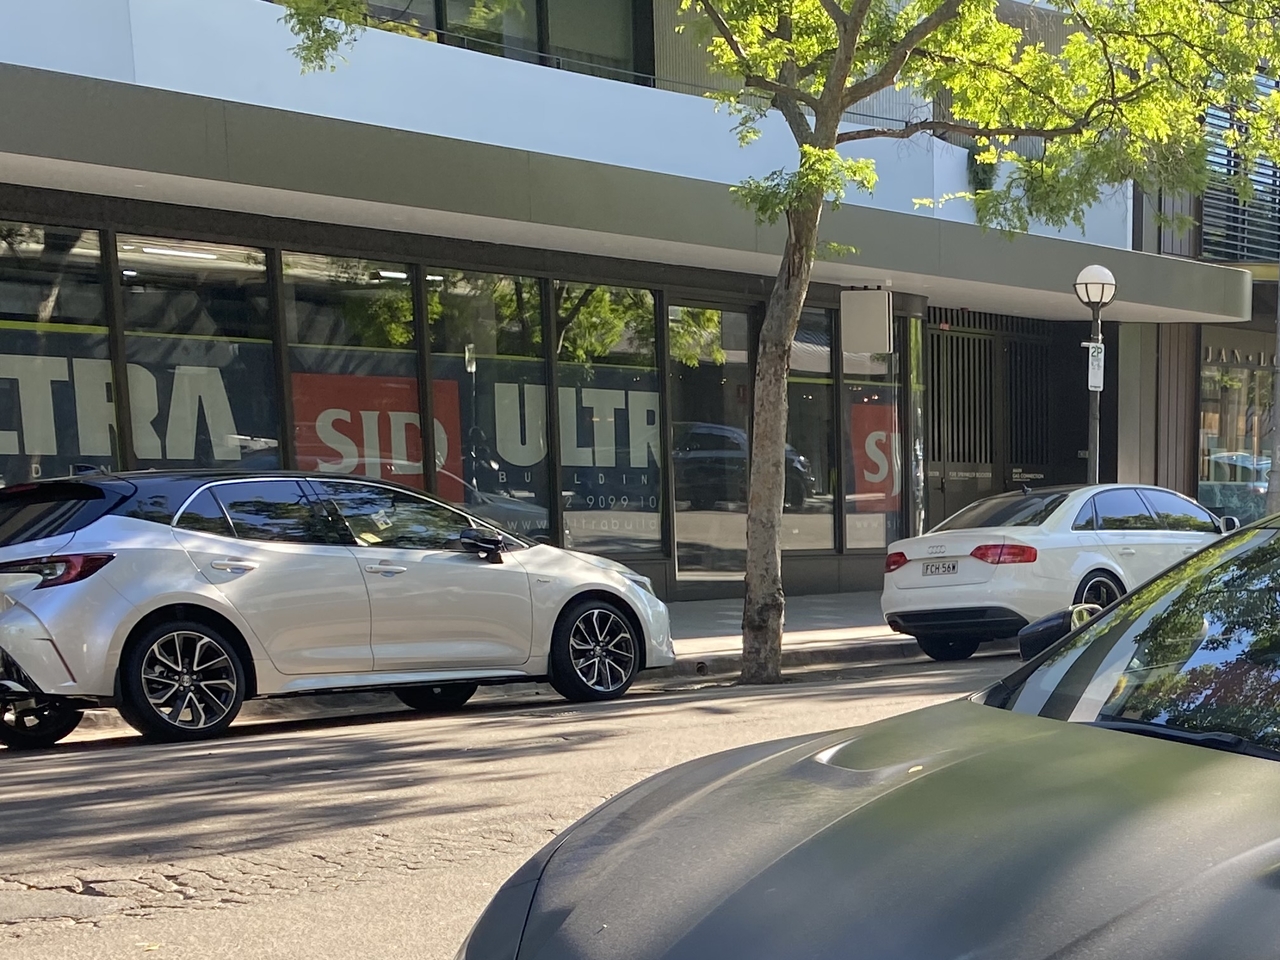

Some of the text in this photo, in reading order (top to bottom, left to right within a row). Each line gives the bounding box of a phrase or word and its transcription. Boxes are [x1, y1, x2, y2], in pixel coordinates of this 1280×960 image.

[1091, 345, 1103, 358] 2P
[1206, 346, 1241, 364] JAN
[494, 382, 661, 469] ULTR
